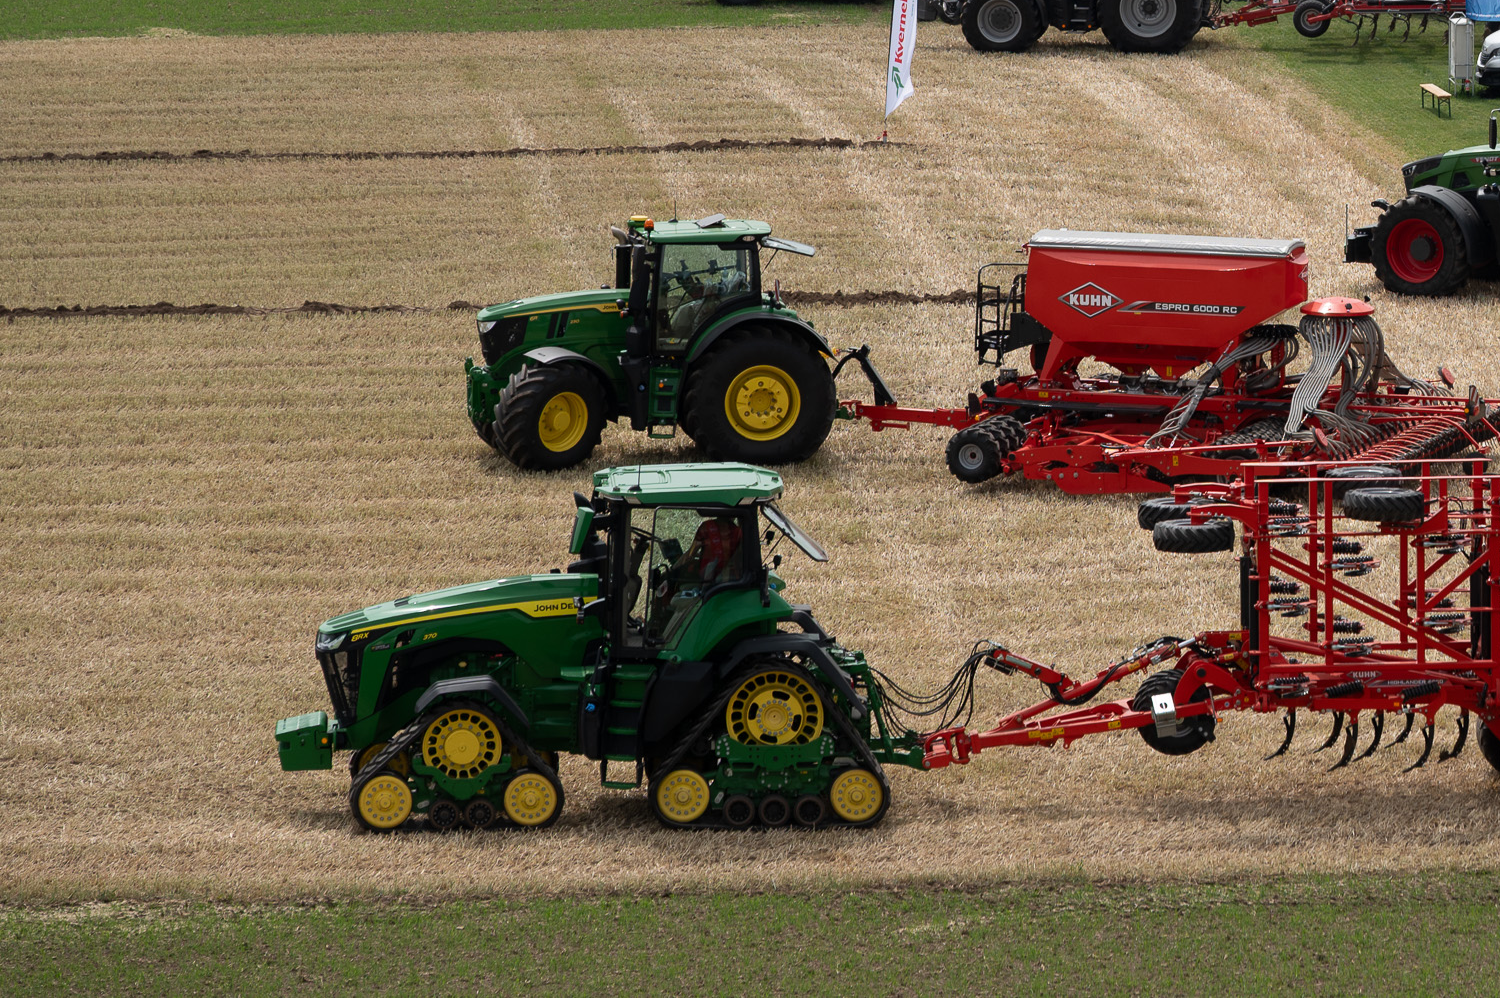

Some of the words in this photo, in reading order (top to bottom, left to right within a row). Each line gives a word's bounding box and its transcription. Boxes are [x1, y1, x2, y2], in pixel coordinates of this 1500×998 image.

[1069, 294, 1112, 307] KUHN
[1155, 303, 1189, 311] ESPRO
[1193, 304, 1219, 313] 6000
[1222, 306, 1237, 314] RC
[533, 603, 558, 612] JOHN
[560, 601, 578, 611] DEE
[351, 631, 370, 642] 8RX
[422, 632, 438, 640] 370
[1352, 670, 1376, 678] KUHN
